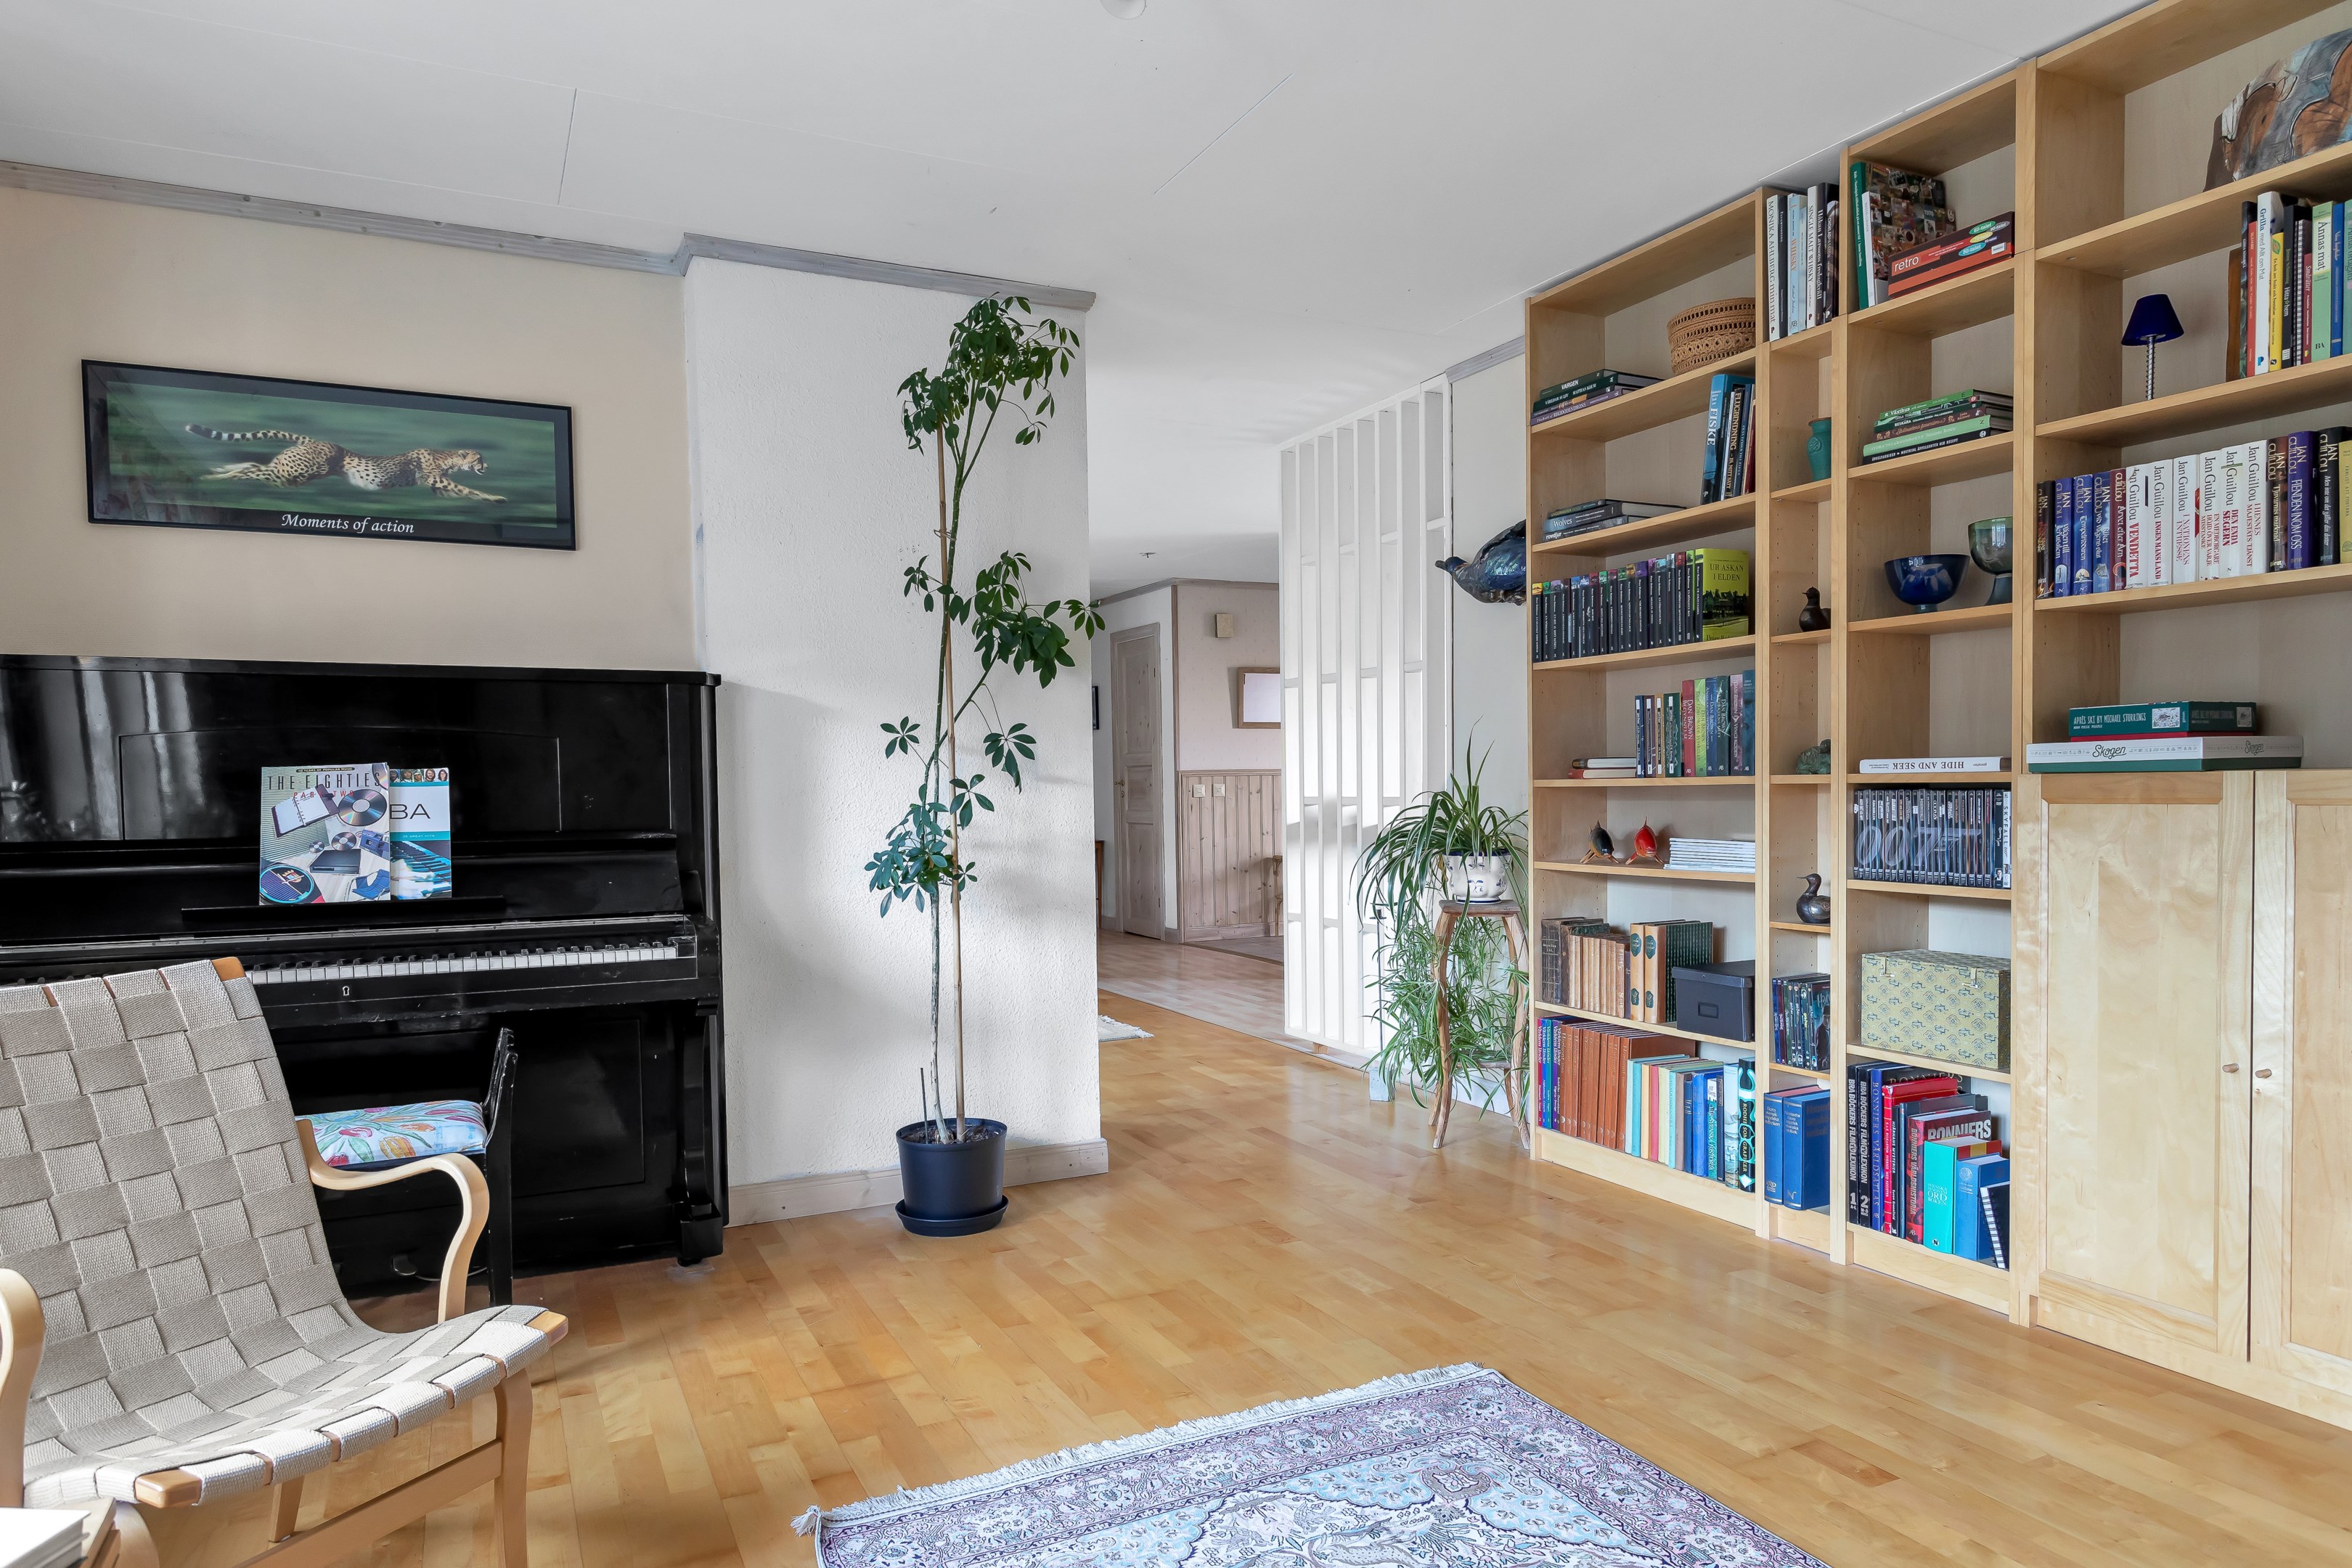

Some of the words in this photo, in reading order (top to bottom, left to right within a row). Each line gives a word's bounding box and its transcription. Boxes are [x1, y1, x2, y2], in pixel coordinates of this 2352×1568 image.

[1974, 223, 1992, 232] 60-talet
[1963, 244, 1981, 254] 50-talet
[1895, 256, 1919, 272] retro
[2259, 259, 2264, 268] om
[2316, 252, 2326, 271] mat
[1561, 380, 1578, 390] VARGEN
[1707, 408, 1718, 445] FISKE
[1730, 393, 1741, 450] FLUGBINDNING
[2226, 451, 2237, 467] Jan
[2248, 446, 2259, 462] Jan
[2296, 446, 2307, 462] JAN
[2327, 444, 2337, 460] JAN
[2178, 461, 2188, 475] Jan
[2205, 457, 2216, 473] Jan
[2276, 453, 2285, 468] JAN
[2129, 469, 2139, 483] Jan
[2154, 466, 2164, 481] Jan
[2226, 467, 2237, 506] Guillou
[2248, 463, 2260, 502] Guillou
[2155, 482, 2165, 519] Guillou
[2178, 476, 2189, 512] Guillou
[2205, 474, 2216, 512] Guillou
[2271, 484, 2281, 515] Tjuvarnas
[2291, 479, 2303, 510] FIENDEN
[2129, 485, 2140, 520] Guillou
[282, 515, 349, 529] Moments
[354, 518, 370, 533] of
[372, 520, 414, 533] action
[1553, 518, 1572, 527] Wolves
[2117, 506, 2126, 526] Arvet
[2291, 513, 2302, 534] INOM
[2322, 511, 2331, 524] gäller
[2129, 523, 2139, 578] VENDETTA
[2290, 535, 2301, 550] OSS
[2117, 544, 2126, 558] Arn
[2074, 715, 2086, 724] APRÈS
[2097, 715, 2102, 724] BY
[2104, 714, 2121, 723] MICHAEL
[2123, 713, 2146, 722] STORRINGS
[2093, 744, 2126, 759] Skogen
[2245, 740, 2264, 756] Skogen
[269, 775, 295, 790] THE
[306, 772, 380, 788] EIGHTIES
[1928, 1119, 1991, 1140] BONNIERS
[1850, 1193, 1856, 1205] 1
[1861, 1196, 1868, 1208] 2
[1928, 1190, 1947, 1201] ORD
